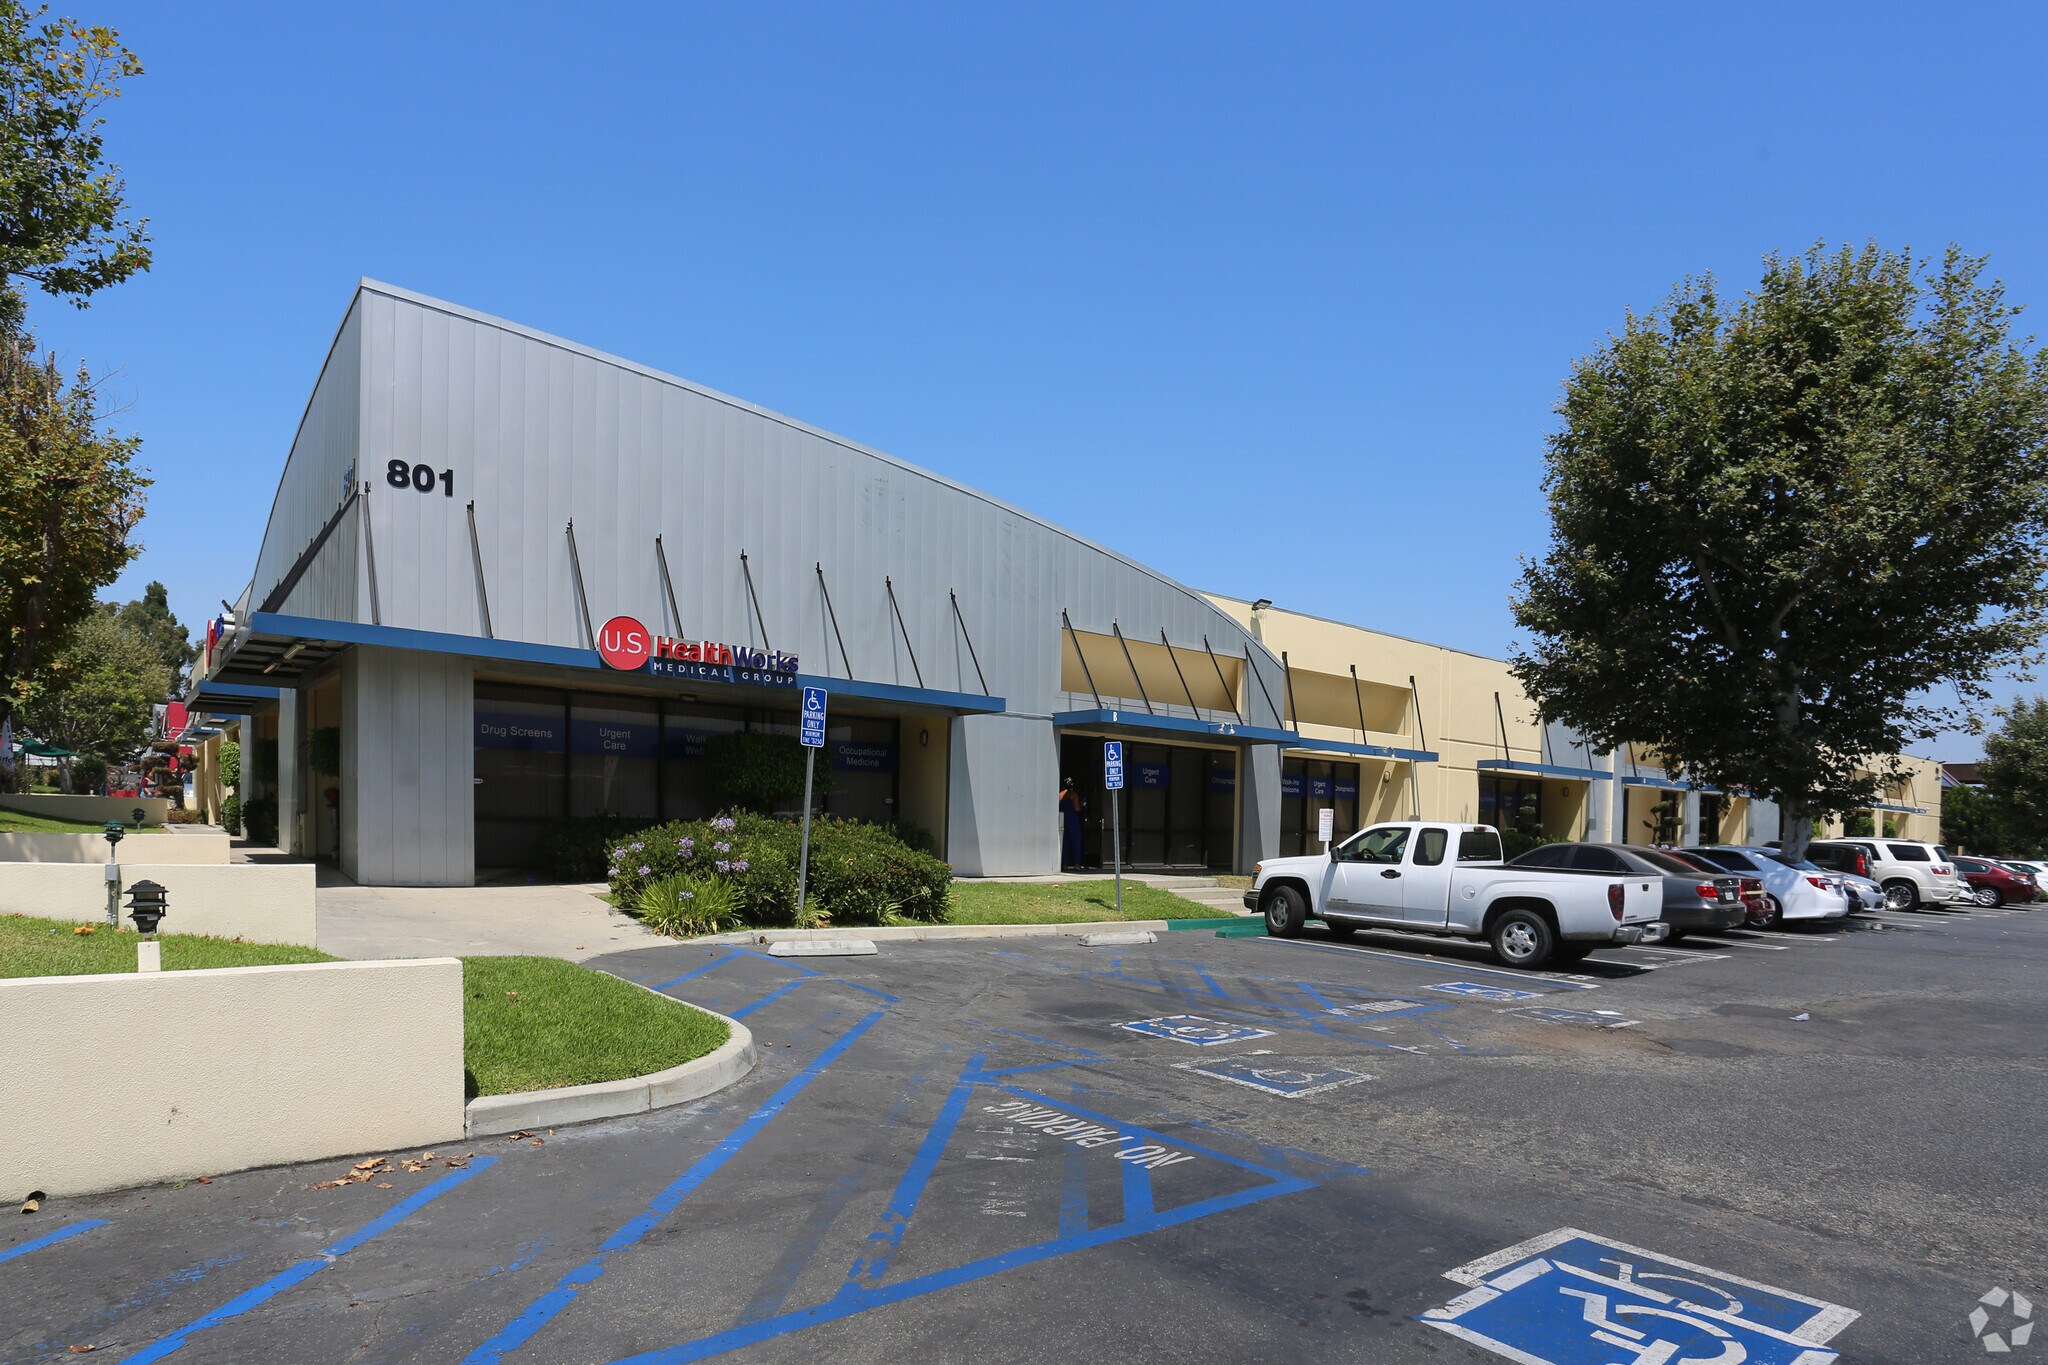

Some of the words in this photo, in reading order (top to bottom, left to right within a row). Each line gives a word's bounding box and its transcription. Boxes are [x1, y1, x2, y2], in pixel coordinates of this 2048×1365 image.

[386, 459, 454, 498] 801
[604, 630, 648, 655] U.S.
[655, 635, 799, 673] HealthWorks
[653, 662, 730, 678] MEDICAL
[741, 671, 795, 685] GROUP
[803, 710, 824, 721] PARKING
[1112, 711, 1118, 722] B
[806, 720, 820, 729] ONLY
[481, 724, 507, 737] Drug
[510, 726, 553, 739] Screens
[599, 728, 631, 740] Urgent
[603, 741, 627, 751] Care
[839, 745, 888, 757] Occupational
[846, 757, 880, 767] Medicine
[1142, 768, 1160, 776] Urgent
[1144, 776, 1157, 784] Care
[983, 1102, 1135, 1148] PARKING
[1113, 1145, 1196, 1169] NO
